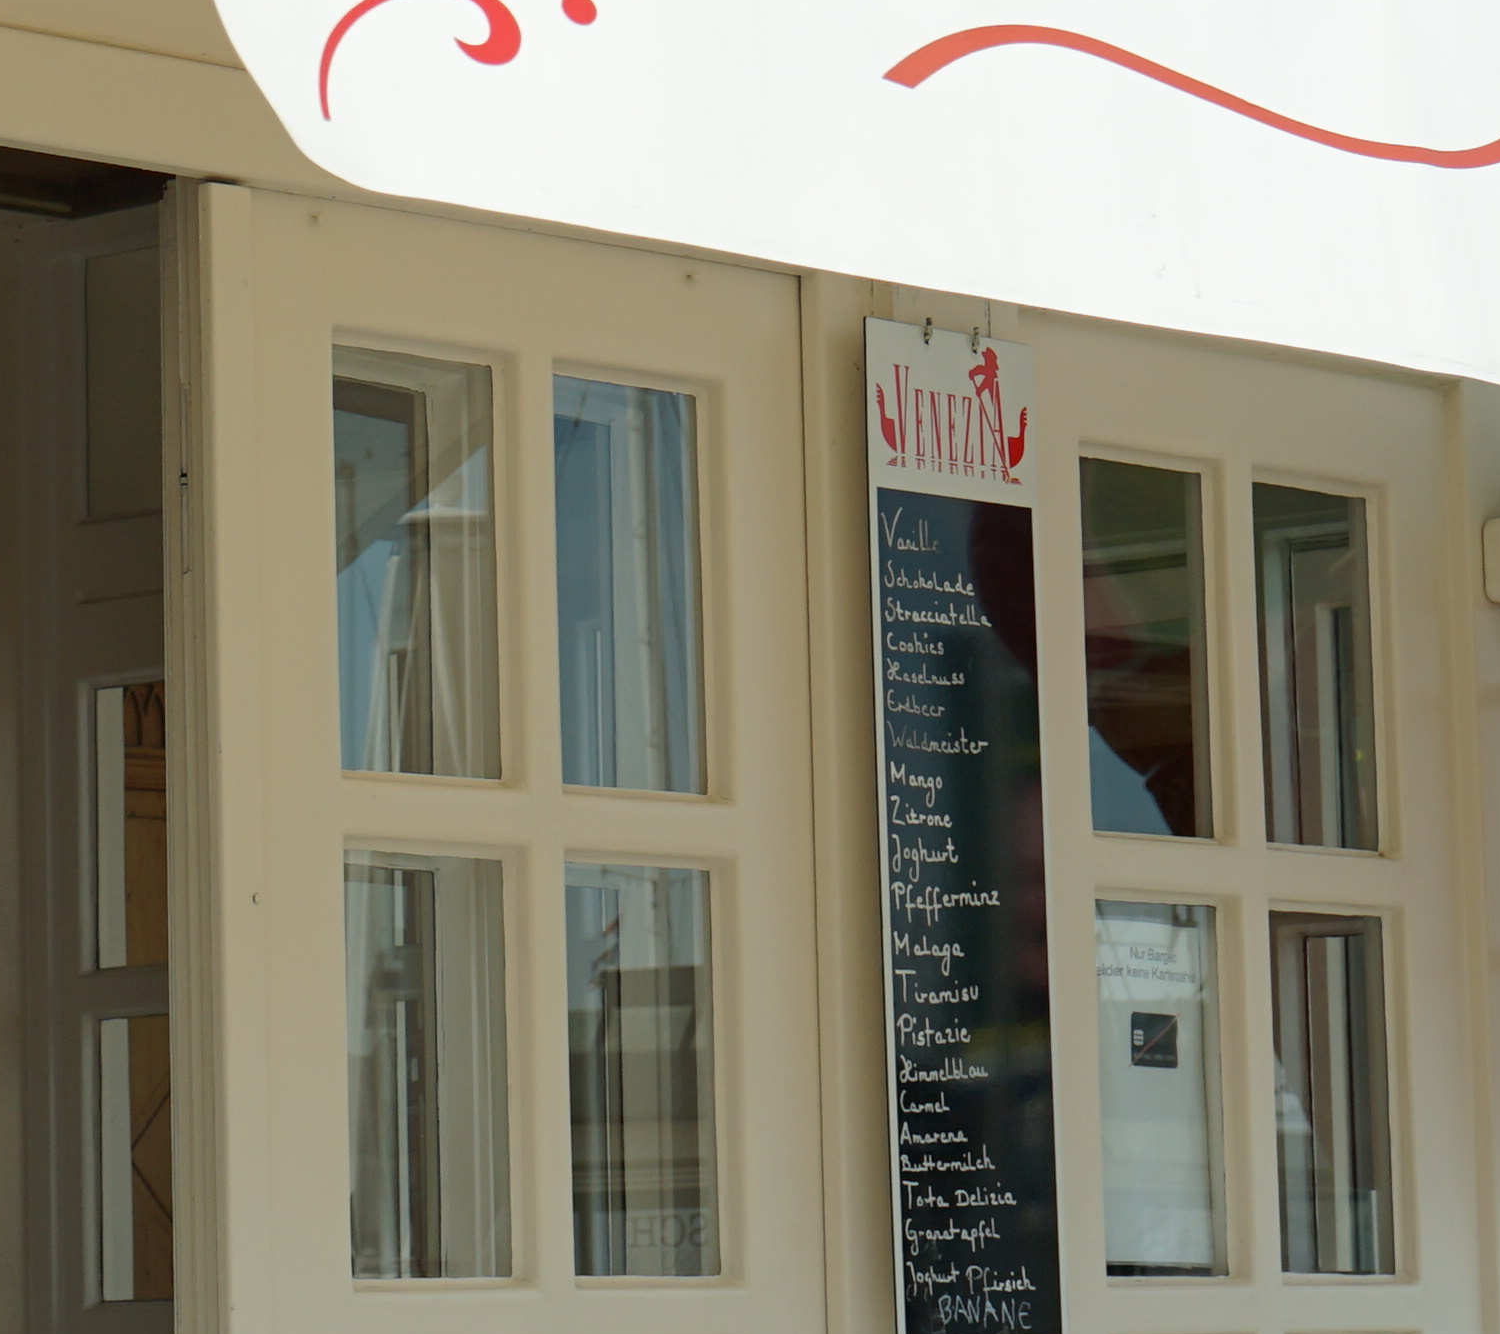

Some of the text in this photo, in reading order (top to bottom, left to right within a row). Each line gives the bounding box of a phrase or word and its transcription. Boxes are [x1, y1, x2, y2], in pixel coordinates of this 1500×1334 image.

[893, 363, 1009, 467] VENEZIA
[884, 559, 976, 597] Schokolade
[885, 596, 993, 627] Stracciatella
[886, 631, 945, 656] Cookies
[886, 657, 965, 686] Haselnuss
[886, 688, 946, 717] Erdbeer
[886, 720, 989, 755] Waldmeister
[890, 761, 943, 808] Mango
[890, 794, 952, 828] Zitrone
[891, 833, 959, 883] Joghurt
[891, 880, 1001, 927] Pfefferminz
[893, 930, 965, 977] Malaga
[894, 969, 979, 1004] Tiramisu
[896, 1012, 971, 1047] Pistazie
[900, 1120, 968, 1145] Amarena
[900, 1143, 996, 1172] Buttermilch
[954, 1181, 1017, 1206] Delizia
[904, 1217, 1001, 1256] Granatapfel
[906, 1260, 1037, 1302] Joghurt Pfirsich
[937, 1293, 1033, 1331] BANANE
